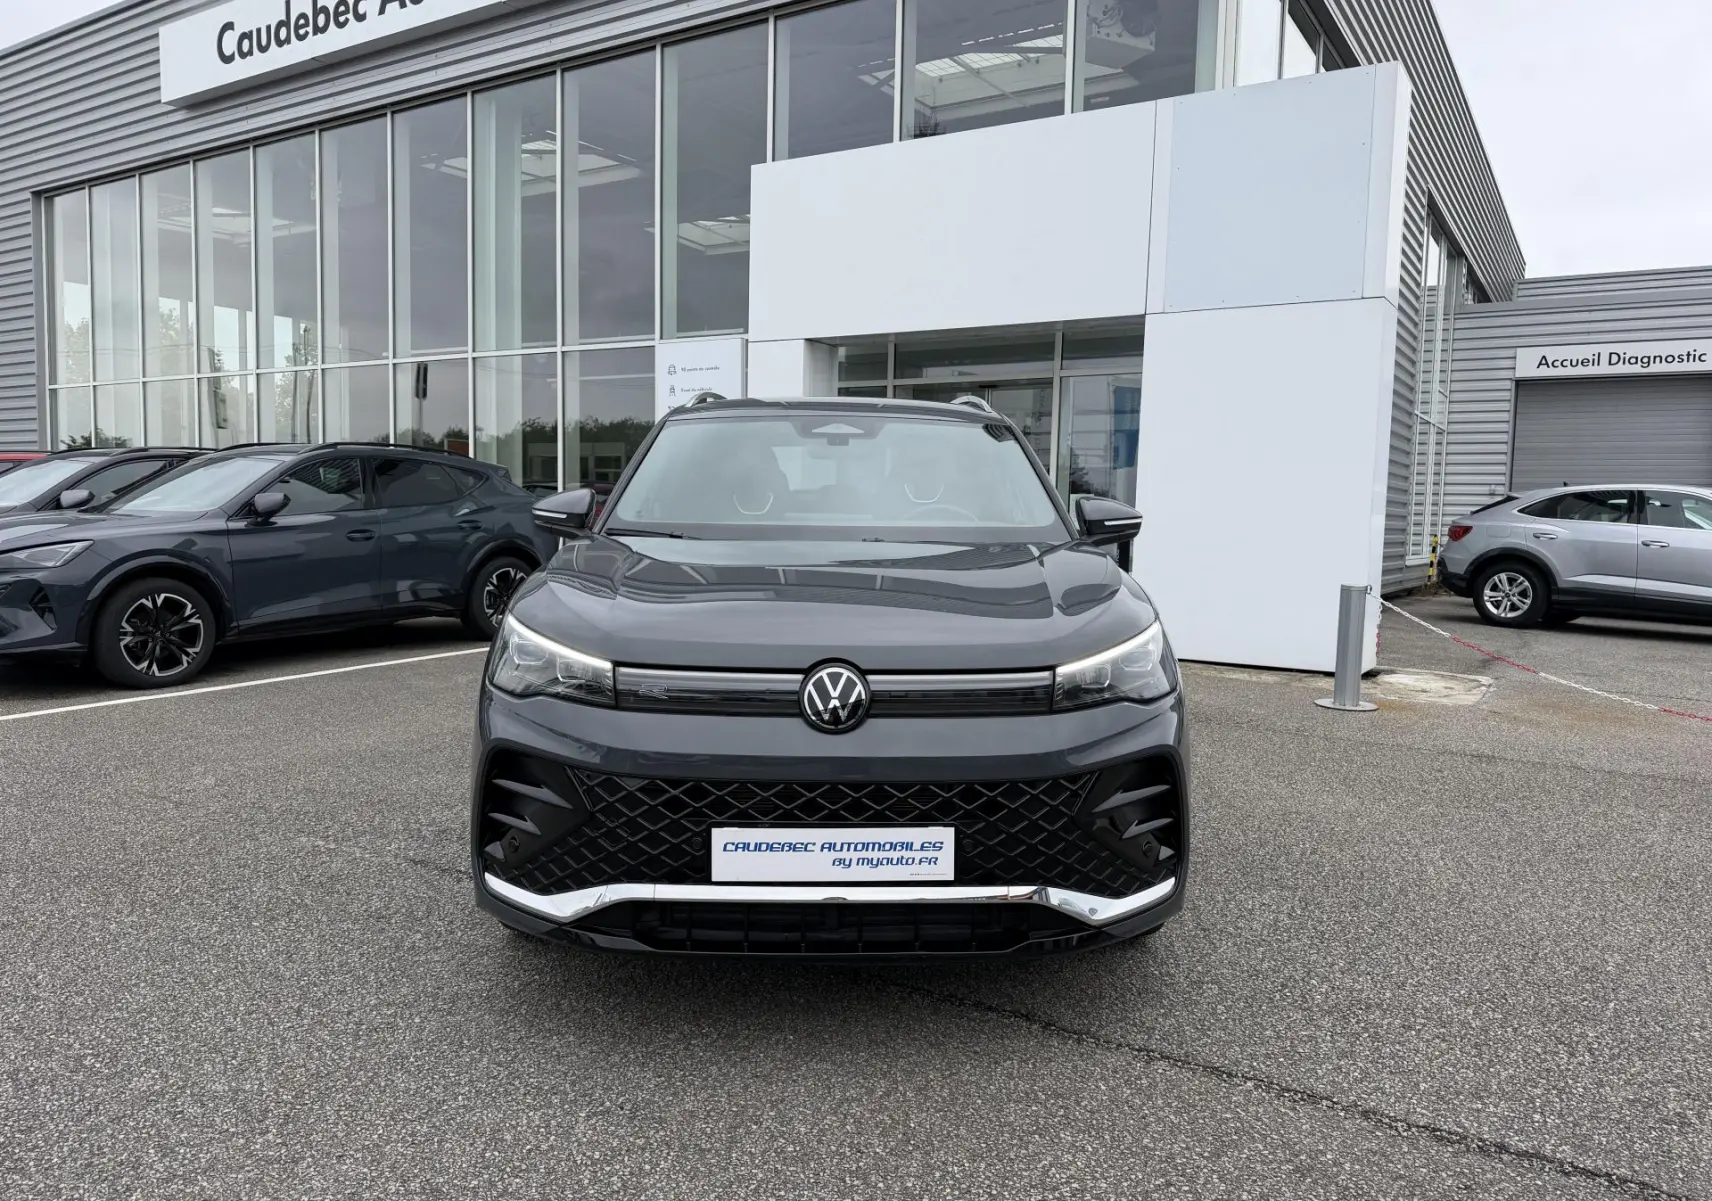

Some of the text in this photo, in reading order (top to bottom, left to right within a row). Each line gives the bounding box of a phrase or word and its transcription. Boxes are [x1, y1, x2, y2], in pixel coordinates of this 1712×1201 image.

[216, 0, 367, 65] Caudebec
[1536, 349, 1708, 369] Accueil Diagnostic
[722, 841, 944, 853] CAUDEBEC AUTOMOBILES
